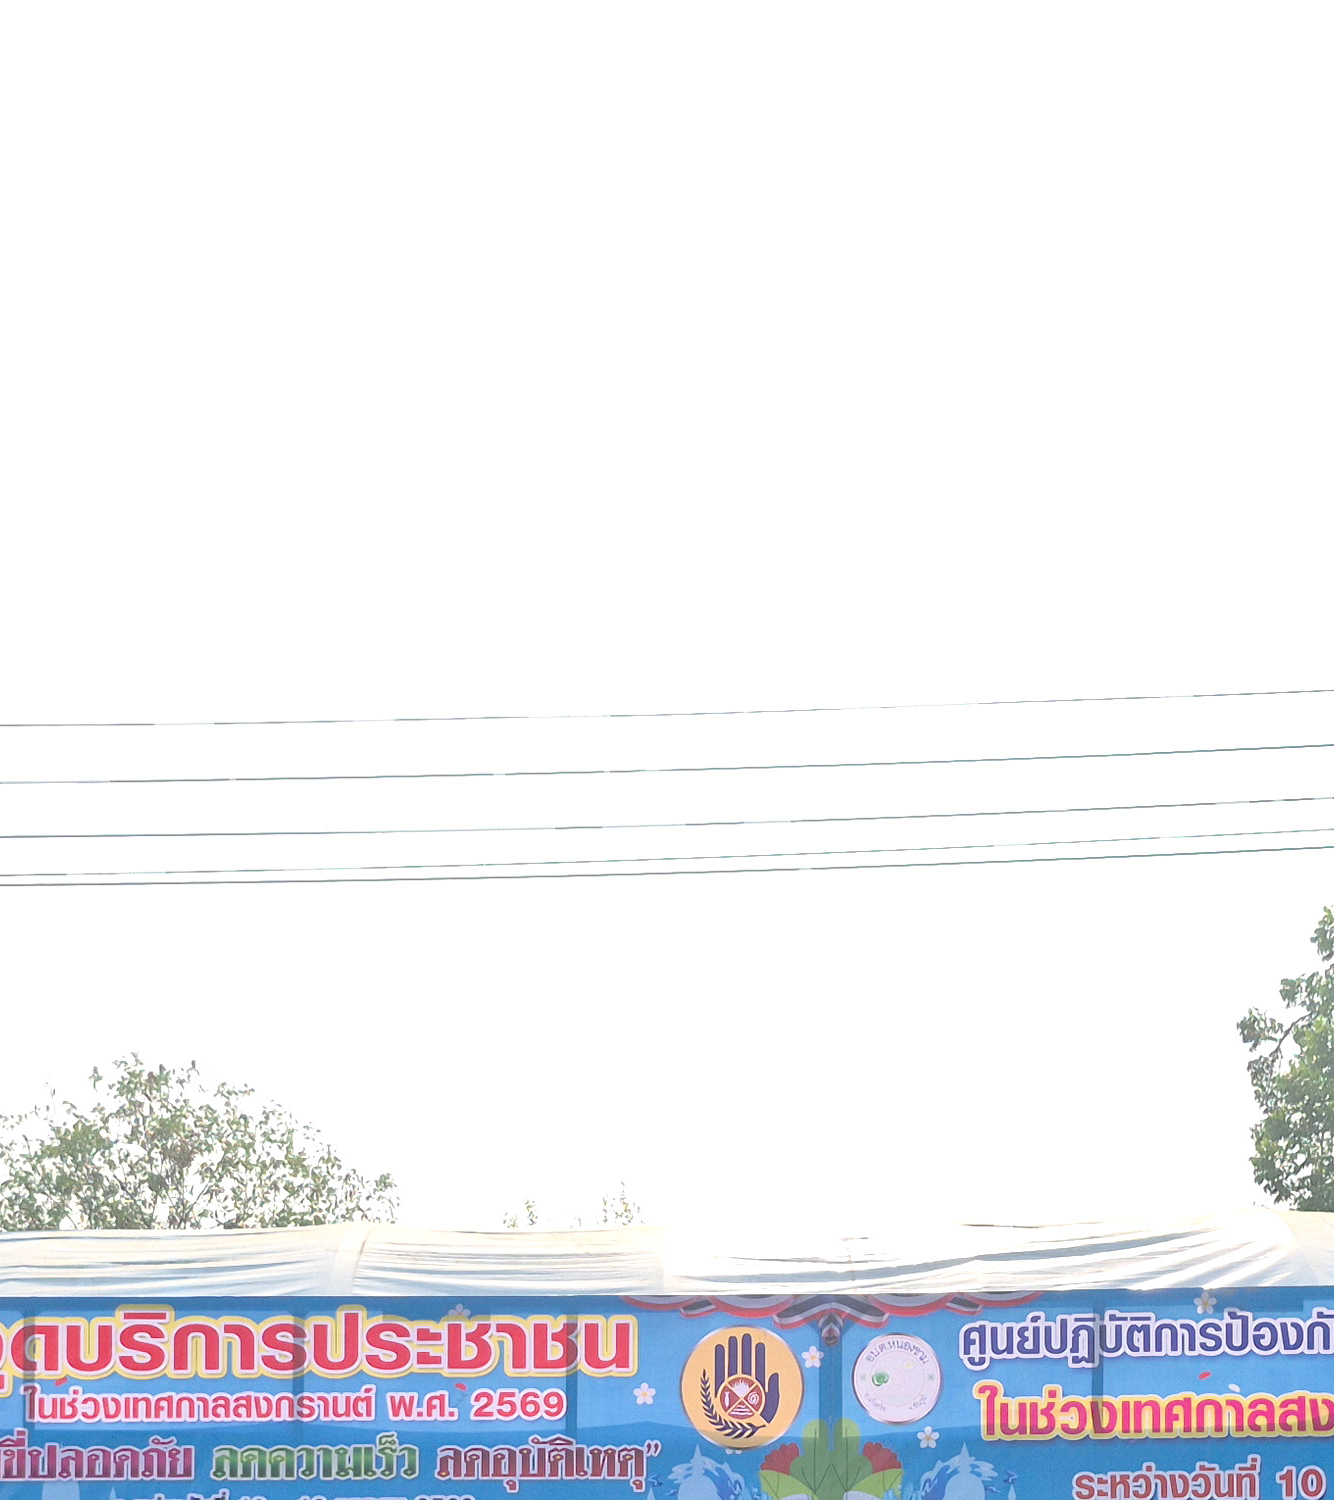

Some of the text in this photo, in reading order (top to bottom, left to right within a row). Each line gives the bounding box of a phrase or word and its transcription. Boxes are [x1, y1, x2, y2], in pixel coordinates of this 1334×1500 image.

[24, 1385, 566, 1420] ในช่วงเทศกาลสงกรานต์ พ.ศ. 2569
[213, 1433, 418, 1479] ลดความเร็ว
[1075, 1457, 1258, 1499] ระหว่างวันที่
[1279, 1469, 1324, 1497] 10
